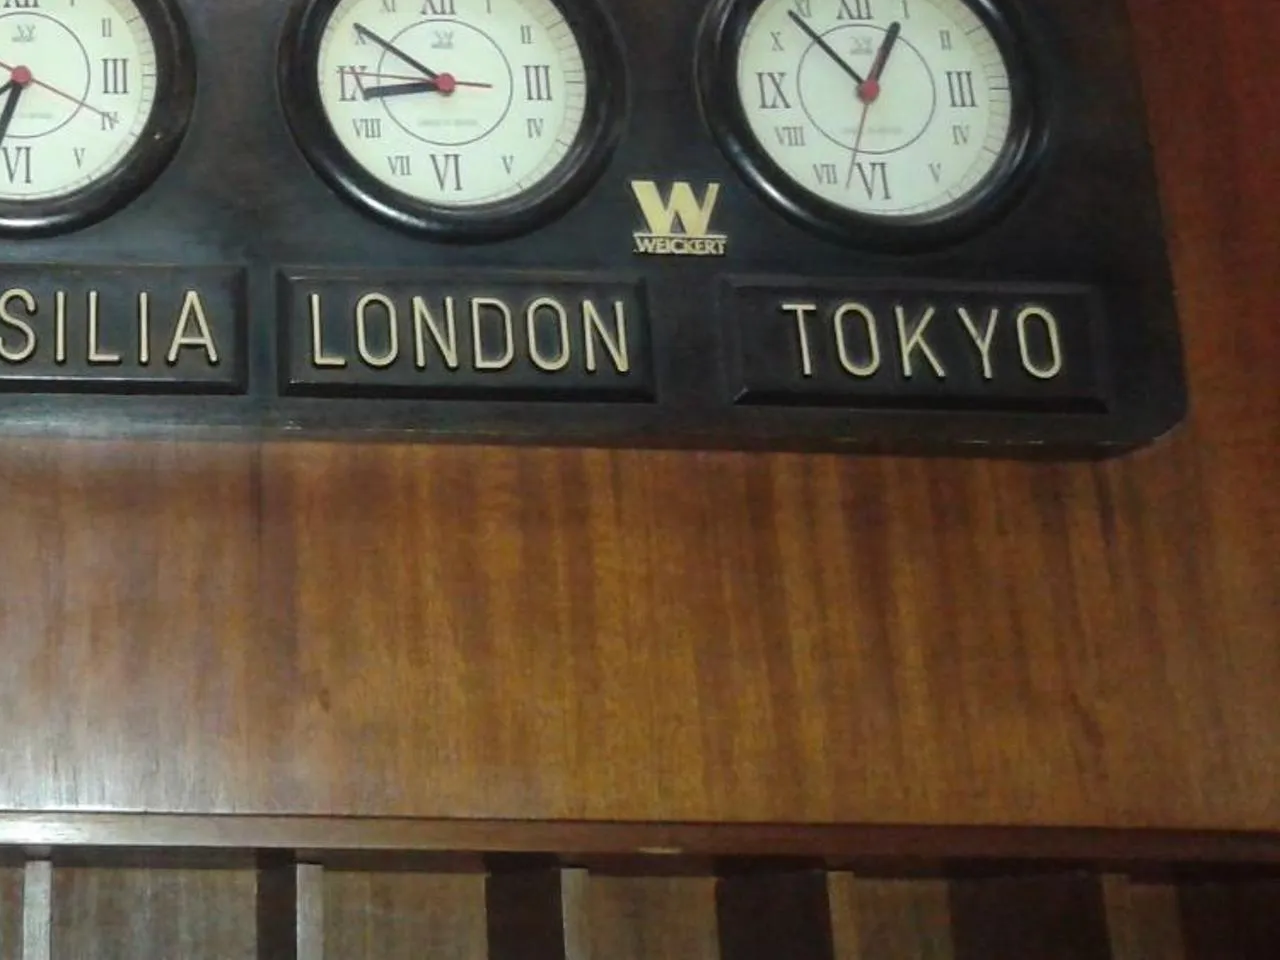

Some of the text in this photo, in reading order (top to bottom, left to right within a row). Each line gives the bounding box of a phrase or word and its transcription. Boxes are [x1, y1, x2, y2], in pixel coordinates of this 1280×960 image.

[902, 0, 910, 19] I
[101, 18, 112, 38] II
[520, 25, 533, 45] II
[770, 31, 785, 52] X
[939, 30, 952, 50] II
[101, 58, 129, 95] III
[336, 65, 369, 102] IX
[523, 65, 553, 102] III
[755, 72, 791, 109] IX
[946, 71, 977, 108] III
[99, 111, 119, 130] IV
[352, 118, 382, 138] VIII
[526, 118, 544, 139] IV
[774, 126, 806, 147] VIII
[952, 125, 970, 145] IV
[1, 146, 32, 184] VI
[73, 147, 86, 169] V
[387, 155, 412, 176] VII
[501, 155, 514, 175] V
[429, 154, 463, 191] VI
[812, 163, 838, 185] VII
[853, 162, 892, 200] VI
[928, 163, 942, 183] V
[310, 291, 631, 373] LONDON
[781, 301, 1063, 380] TOKYO
